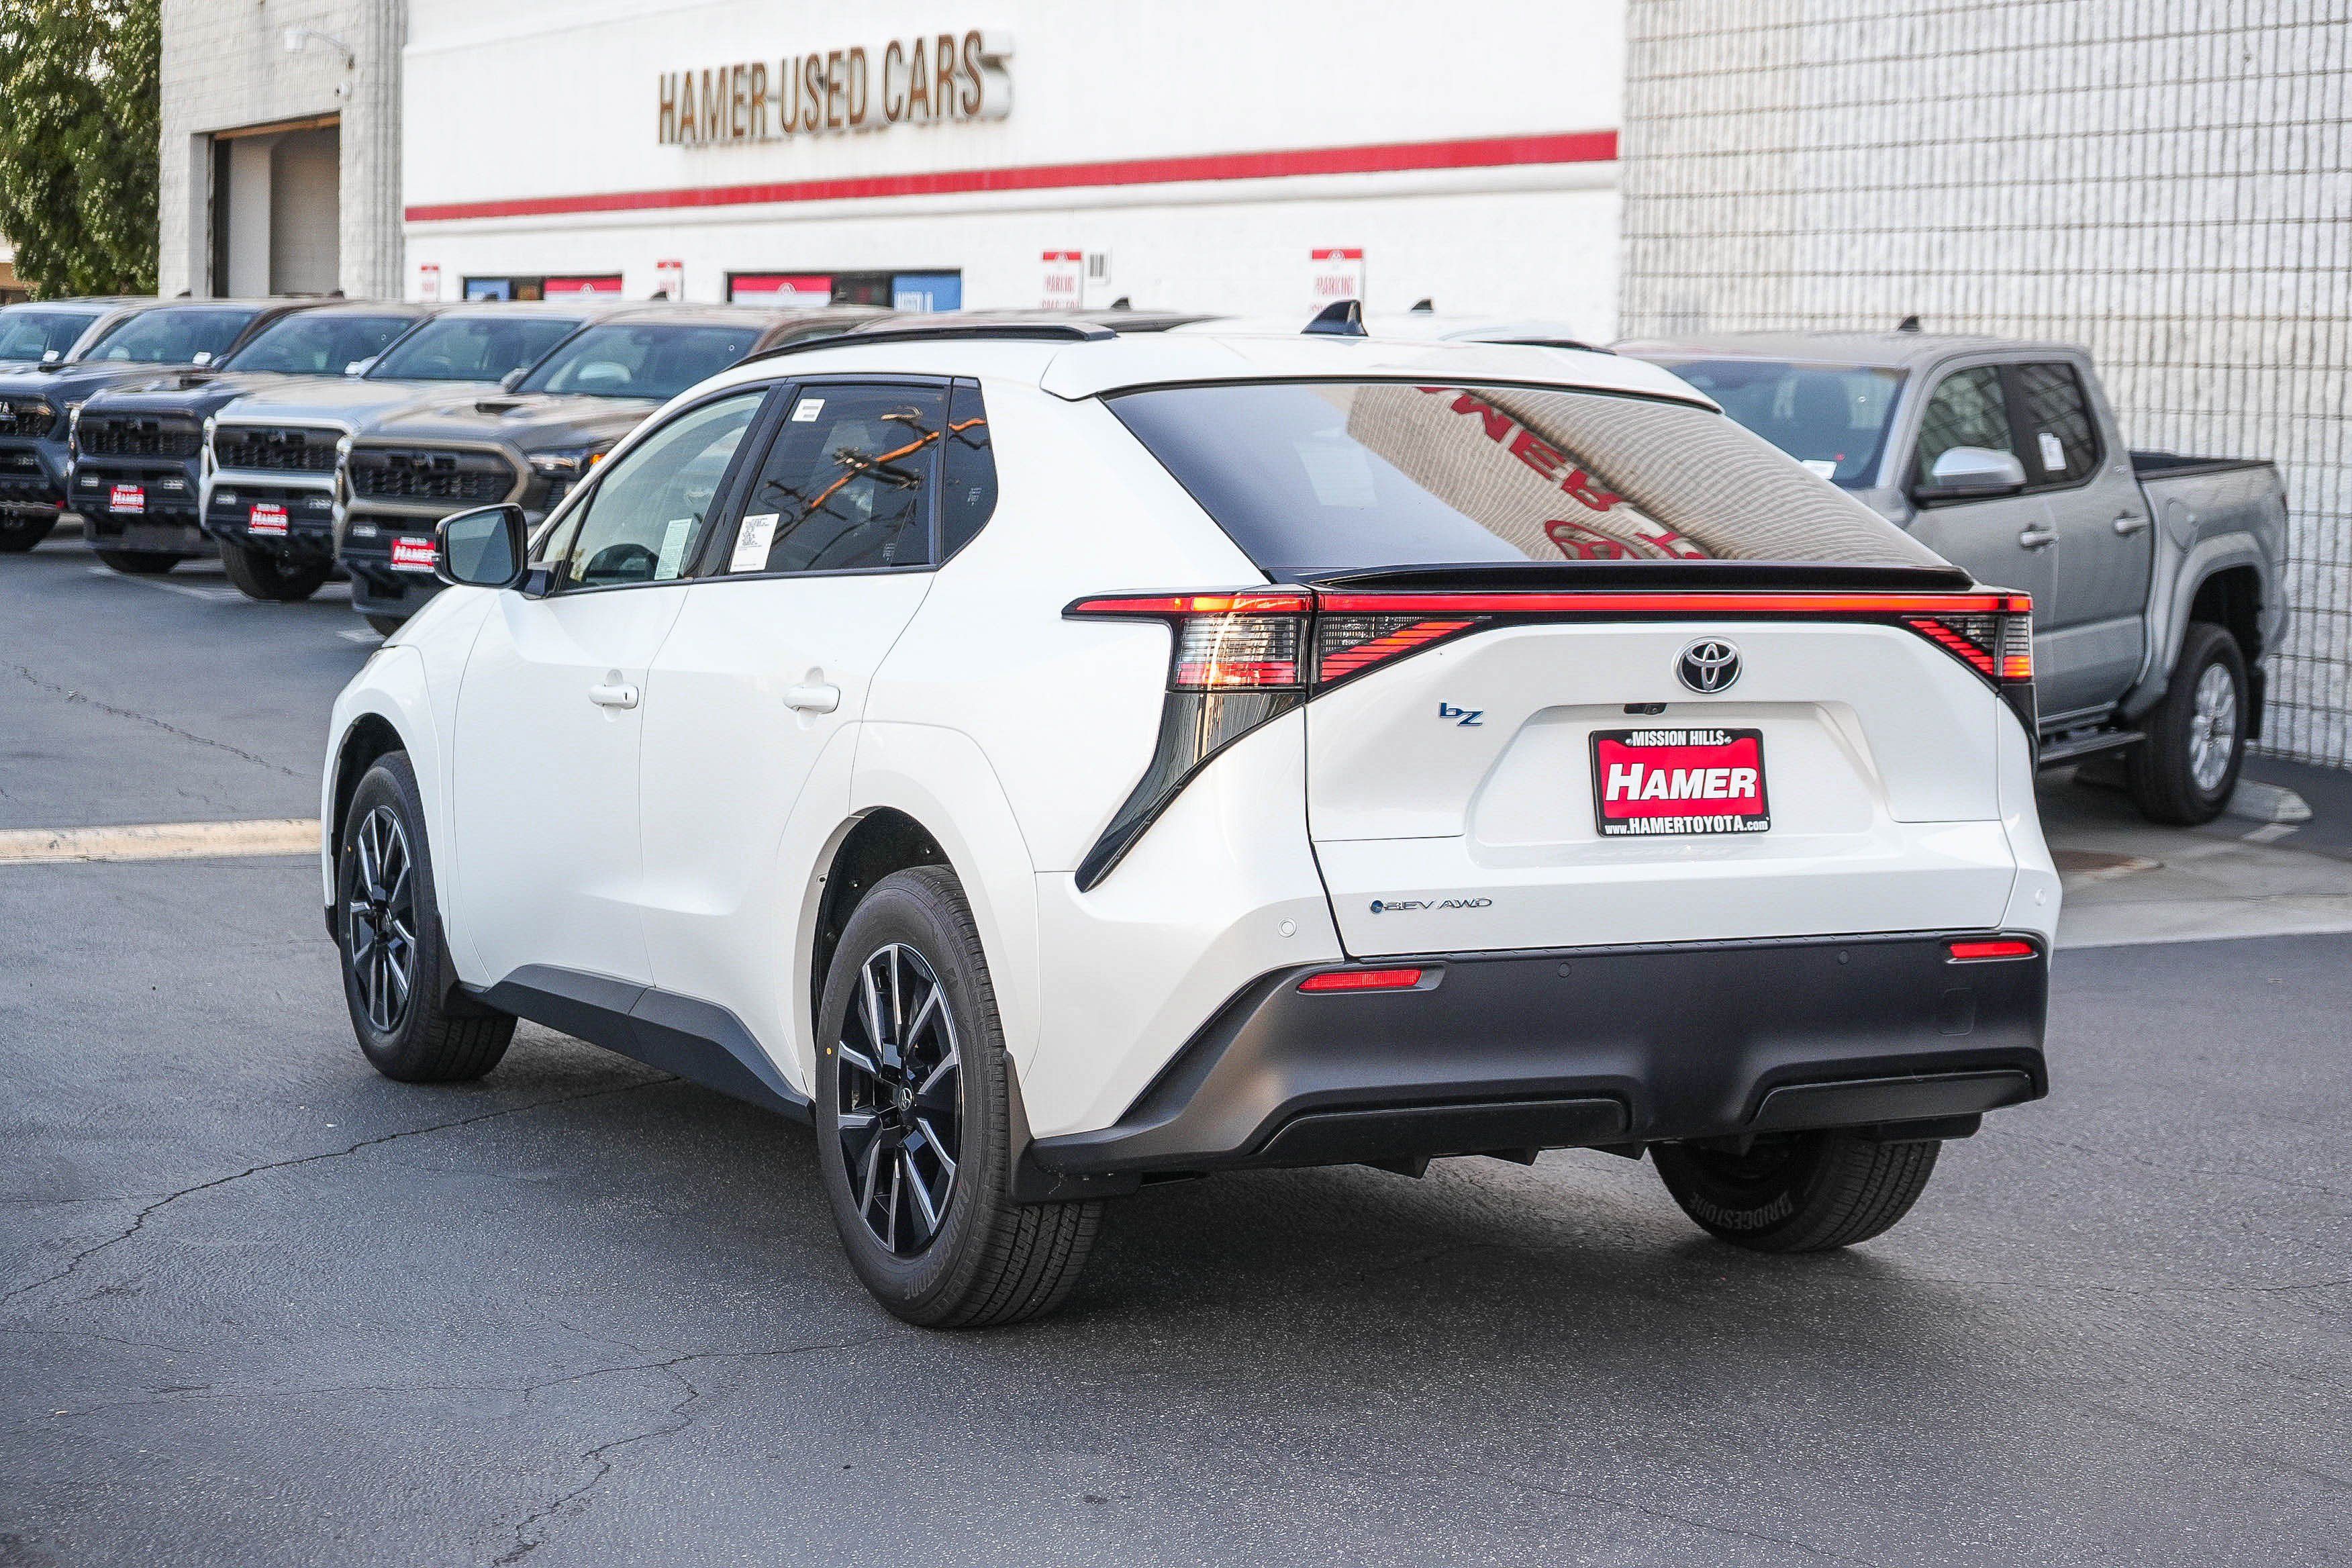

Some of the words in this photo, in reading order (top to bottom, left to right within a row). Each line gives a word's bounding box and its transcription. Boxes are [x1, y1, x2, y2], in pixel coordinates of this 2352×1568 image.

[659, 62, 767, 144] HAMER
[779, 46, 868, 134] USED
[881, 30, 983, 124] CARS
[1632, 731, 1687, 746] MISSION
[1689, 730, 1725, 746] HILLS
[1605, 763, 1758, 801] HAMER
[1605, 815, 1768, 834] www.HAMERTOYOTA.com
[1438, 897, 1493, 910] AWD
